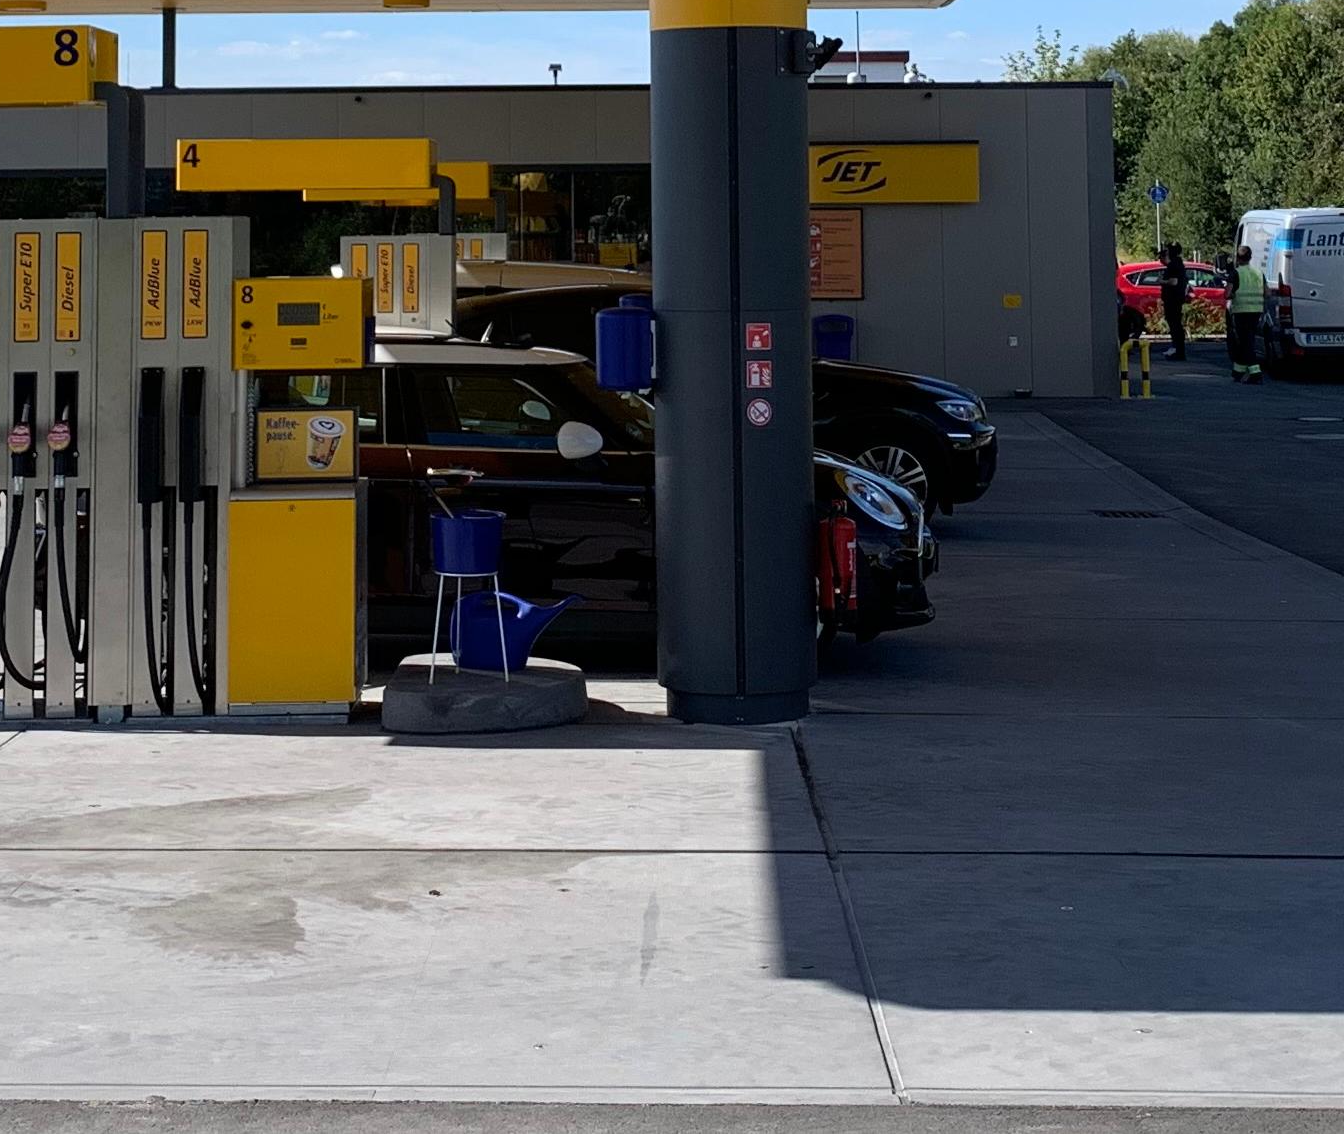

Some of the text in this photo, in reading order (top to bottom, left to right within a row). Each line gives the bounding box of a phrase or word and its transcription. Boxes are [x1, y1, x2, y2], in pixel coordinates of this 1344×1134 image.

[53, 29, 79, 67] 8
[182, 143, 201, 168] 4
[821, 161, 882, 183] JET
[19, 242, 36, 312] Super E10
[61, 266, 74, 312] Diesel
[147, 258, 160, 310] AdBlue
[189, 257, 202, 308] AdBlue
[380, 249, 393, 294] Super E10
[241, 285, 253, 304] 8
[266, 417, 300, 429] Kaffee-
